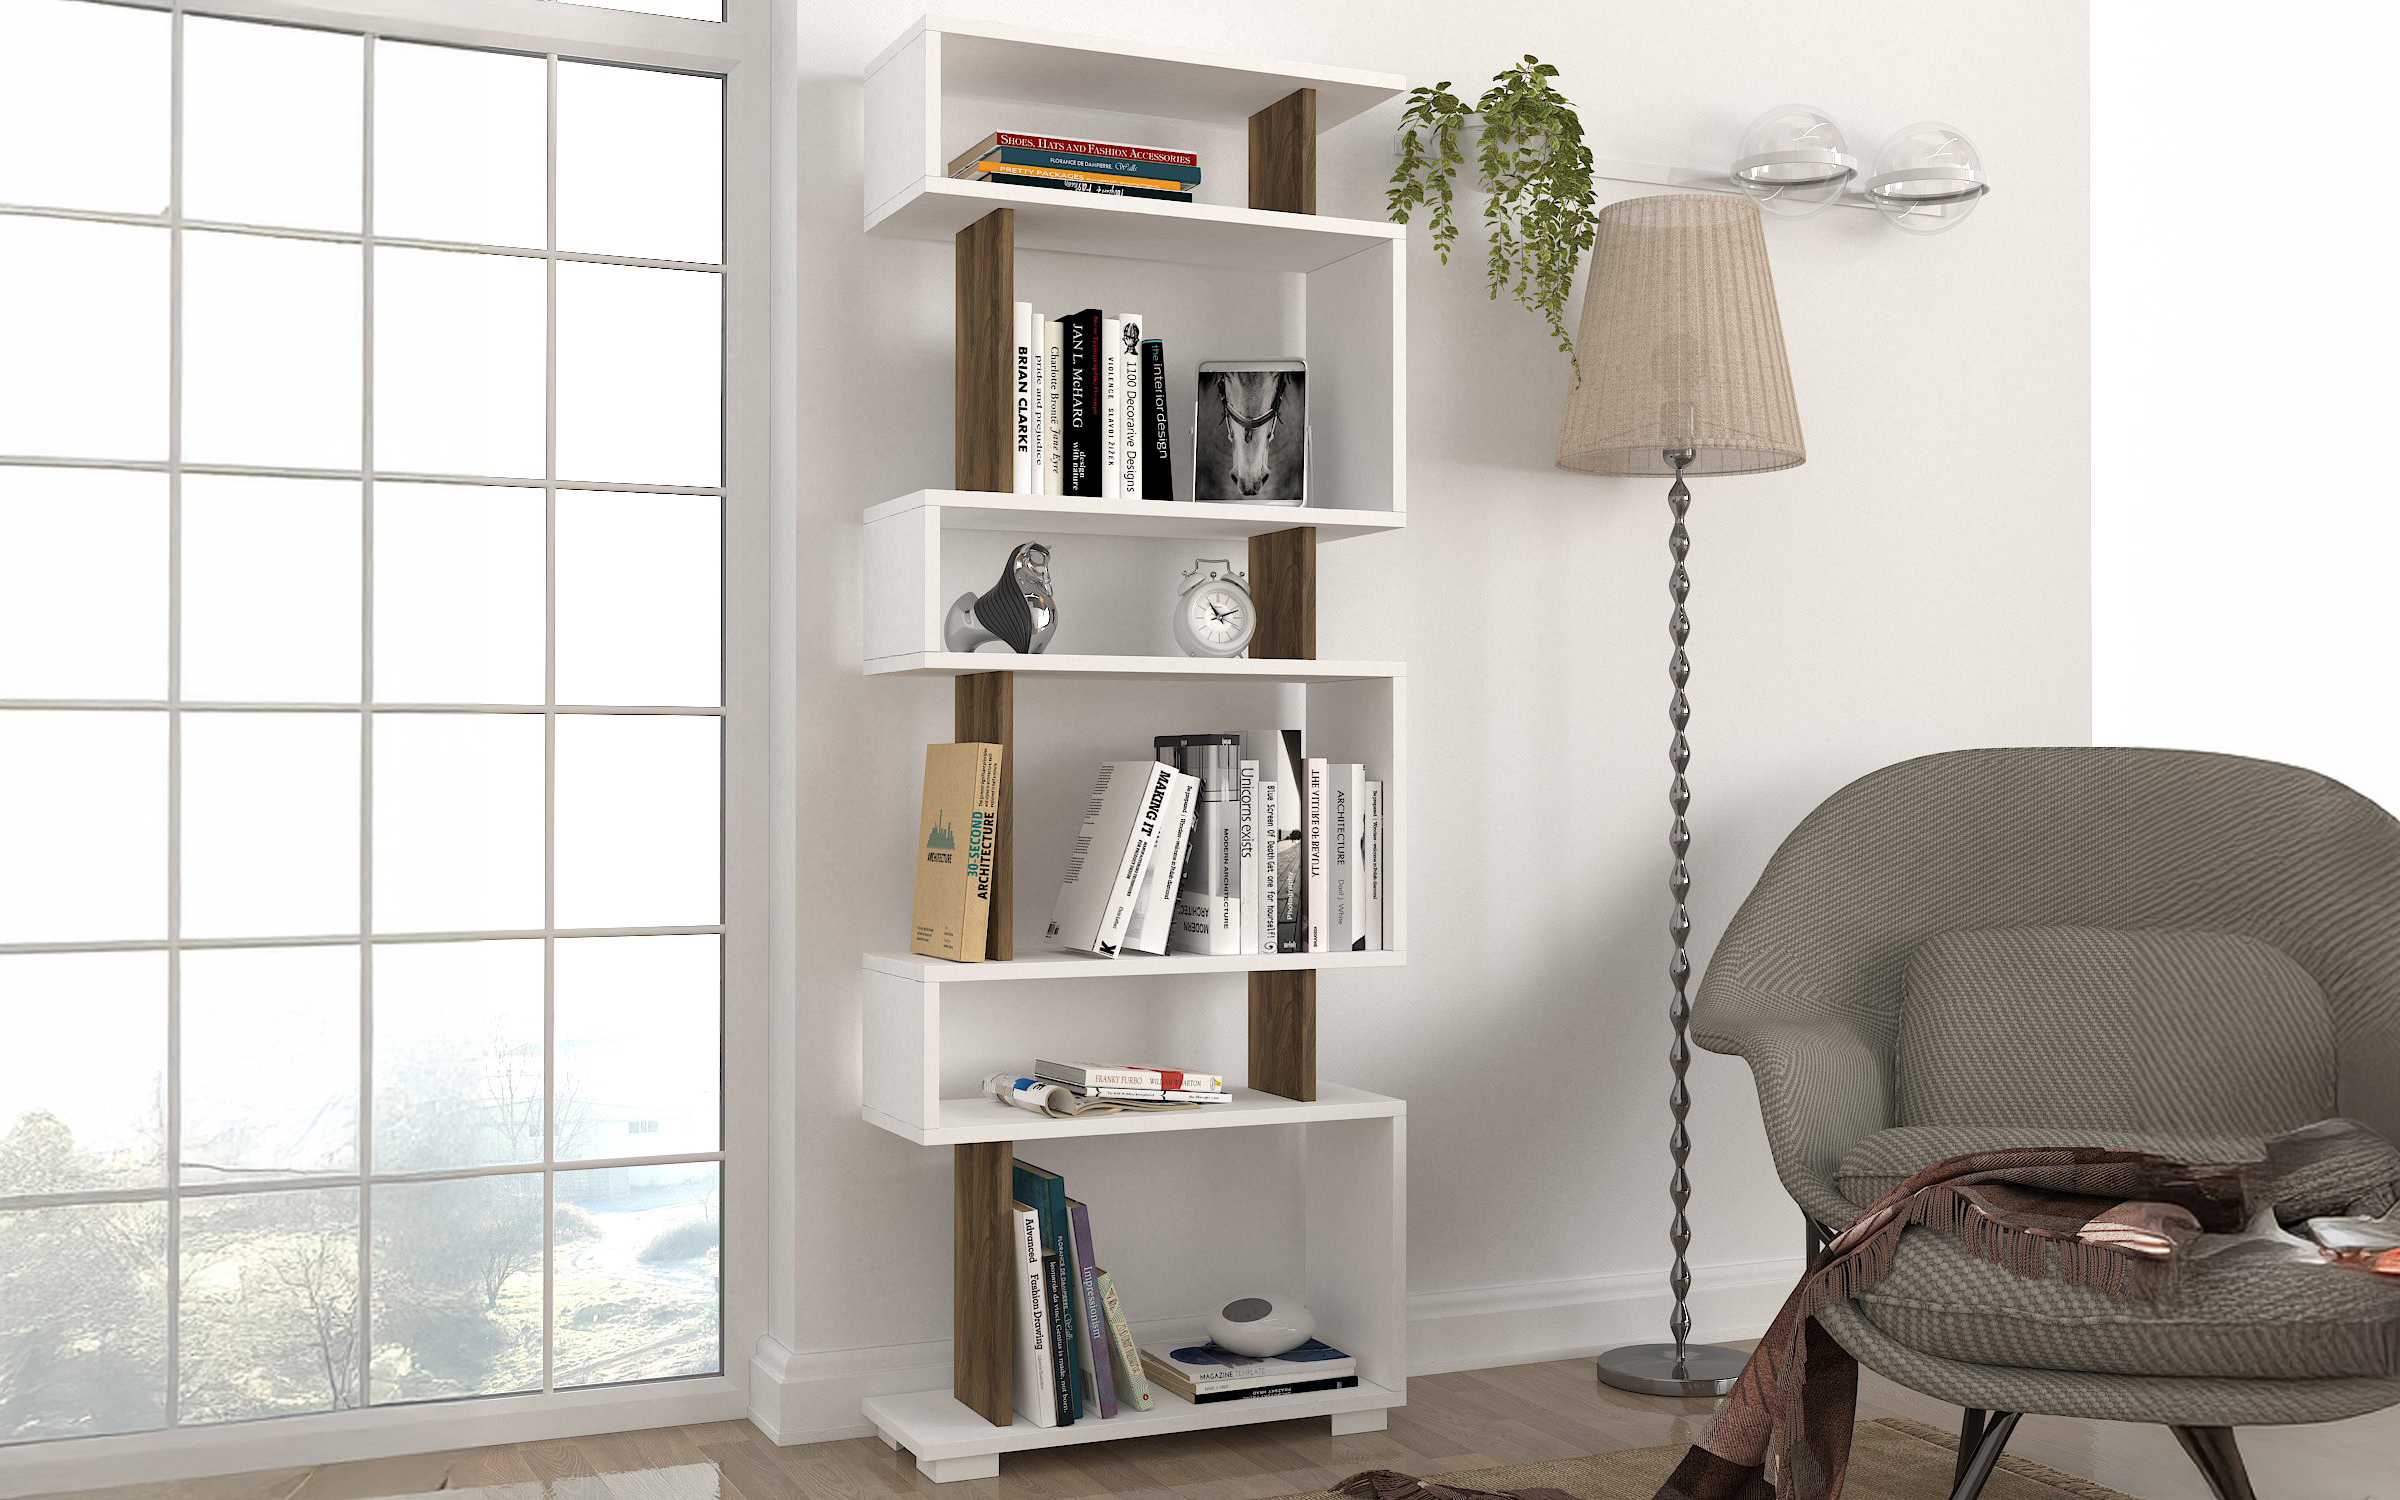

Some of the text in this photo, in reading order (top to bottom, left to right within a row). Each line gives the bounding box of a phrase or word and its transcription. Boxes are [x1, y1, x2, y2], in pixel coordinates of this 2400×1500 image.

[1038, 138, 1065, 151] HATS
[1066, 144, 1086, 153] AND
[1088, 144, 1128, 158] FASHION
[1129, 149, 1191, 165] ACCESSORIES
[999, 166, 1085, 181] PRETTY PACKAGES
[1152, 345, 1160, 361] the
[1035, 355, 1043, 385] pride
[1051, 346, 1060, 390] Charlotte
[1073, 323, 1084, 428] JAN L. McHARG
[1018, 346, 1028, 453] BRIAN CLARKE
[1035, 412, 1043, 466] prejudice
[1050, 427, 1061, 450] Jane
[1124, 361, 1137, 492] 1100 Decorarive Designs
[1050, 453, 1061, 474] Eyre
[1078, 451, 1087, 478] design
[1146, 770, 1171, 821] MAKING
[1267, 785, 1275, 801] Blue
[1241, 768, 1254, 858] Unicorns exists
[1267, 804, 1275, 827] Screen
[1141, 821, 1154, 836] IT
[1267, 829, 1275, 838] Of
[1337, 790, 1345, 865] ARCHITECTURE
[967, 811, 983, 876] 30-SECOND
[977, 812, 994, 900] ARCHITECTURE
[1267, 841, 1275, 860] Death
[1267, 860, 1275, 873] Get
[1267, 891, 1275, 901] for
[1286, 871, 1294, 920] Photography
[1178, 905, 1209, 918] ARCHITEC
[1095, 1074, 1119, 1084] FRANKY
[1120, 1076, 1143, 1085] FURBO
[1026, 1218, 1037, 1263] Advanced
[1060, 1267, 1066, 1277] DE
[1030, 1273, 1041, 1309] Fashion
[1053, 1294, 1060, 1303] da
[1083, 1265, 1101, 1339] Impressionism
[1033, 1311, 1044, 1350] Drawing
[1200, 1367, 1266, 1381] MAGAZINE TEMPLATE
